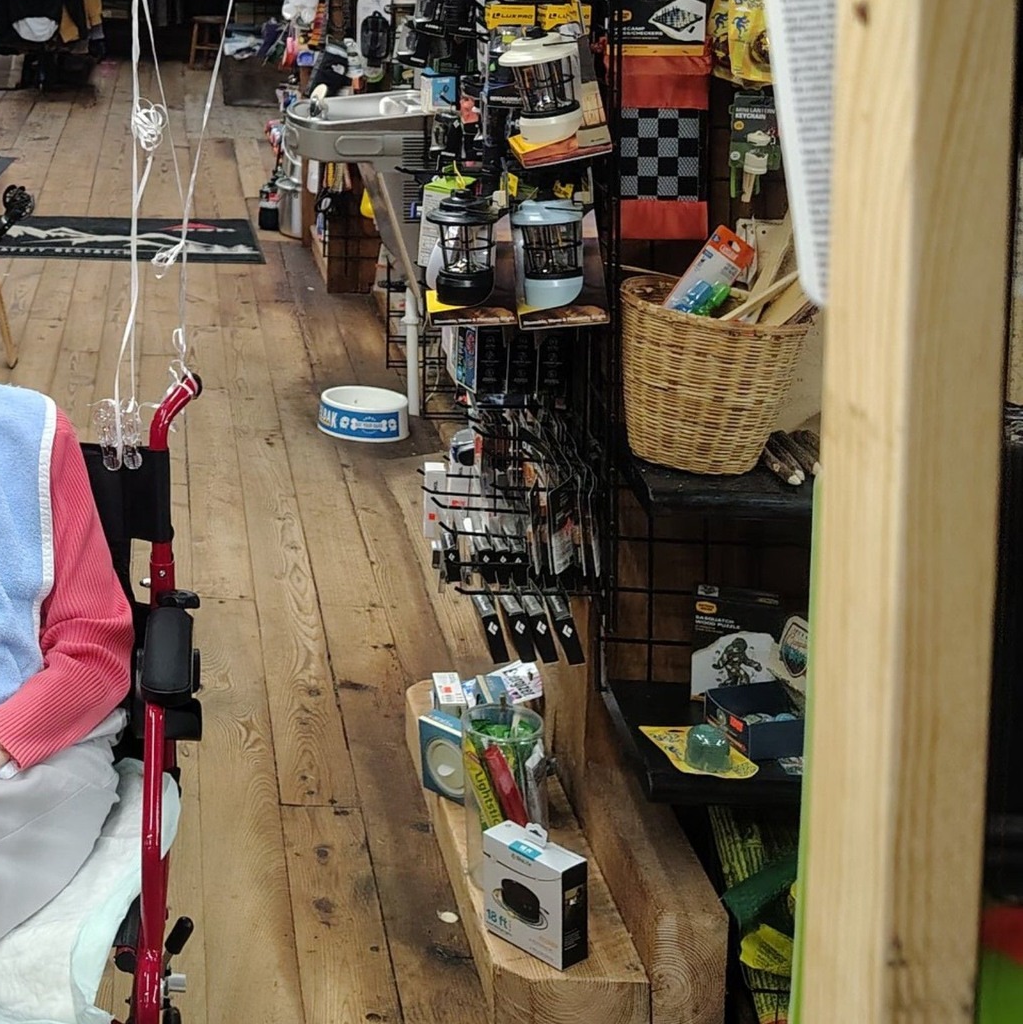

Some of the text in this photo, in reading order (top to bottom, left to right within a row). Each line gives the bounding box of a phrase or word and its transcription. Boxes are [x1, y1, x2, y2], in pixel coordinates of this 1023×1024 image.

[695, 614, 735, 624] SASQUATCH
[716, 622, 741, 630] PUZZLE
[475, 771, 503, 826] Lightstic
